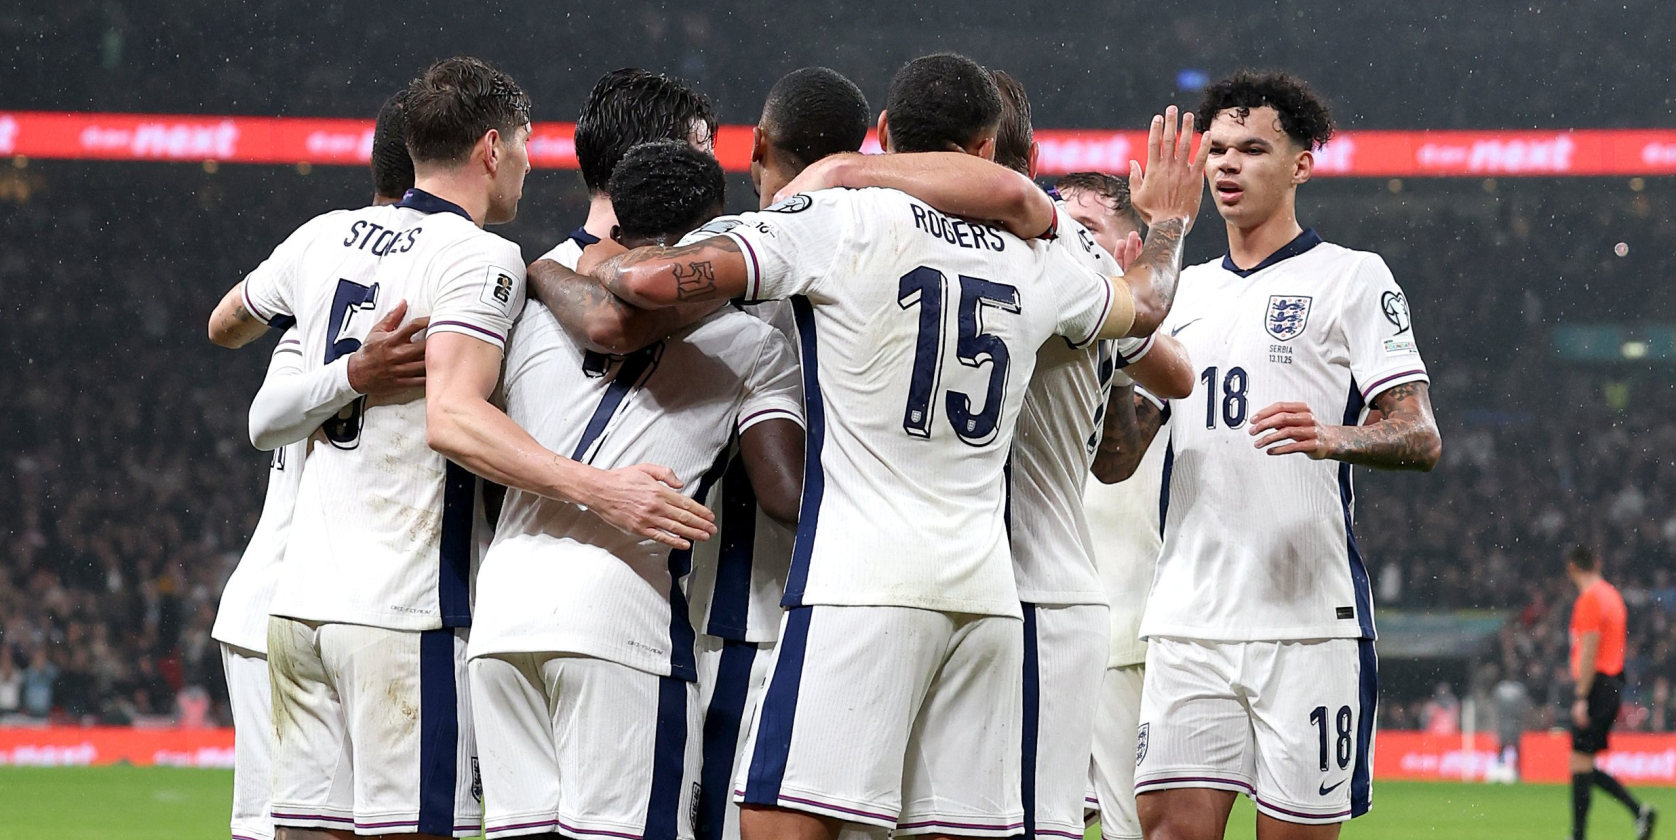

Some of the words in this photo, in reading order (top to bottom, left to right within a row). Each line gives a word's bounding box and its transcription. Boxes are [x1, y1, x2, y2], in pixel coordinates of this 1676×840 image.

[1468, 134, 1574, 172] next
[910, 203, 1005, 252] ROGERS
[897, 265, 1021, 447] 15
[1269, 344, 1293, 354] SERBIA
[1269, 354, 1293, 364] 13.11.25
[1200, 366, 1250, 430] 18
[1309, 705, 1353, 772] 18
